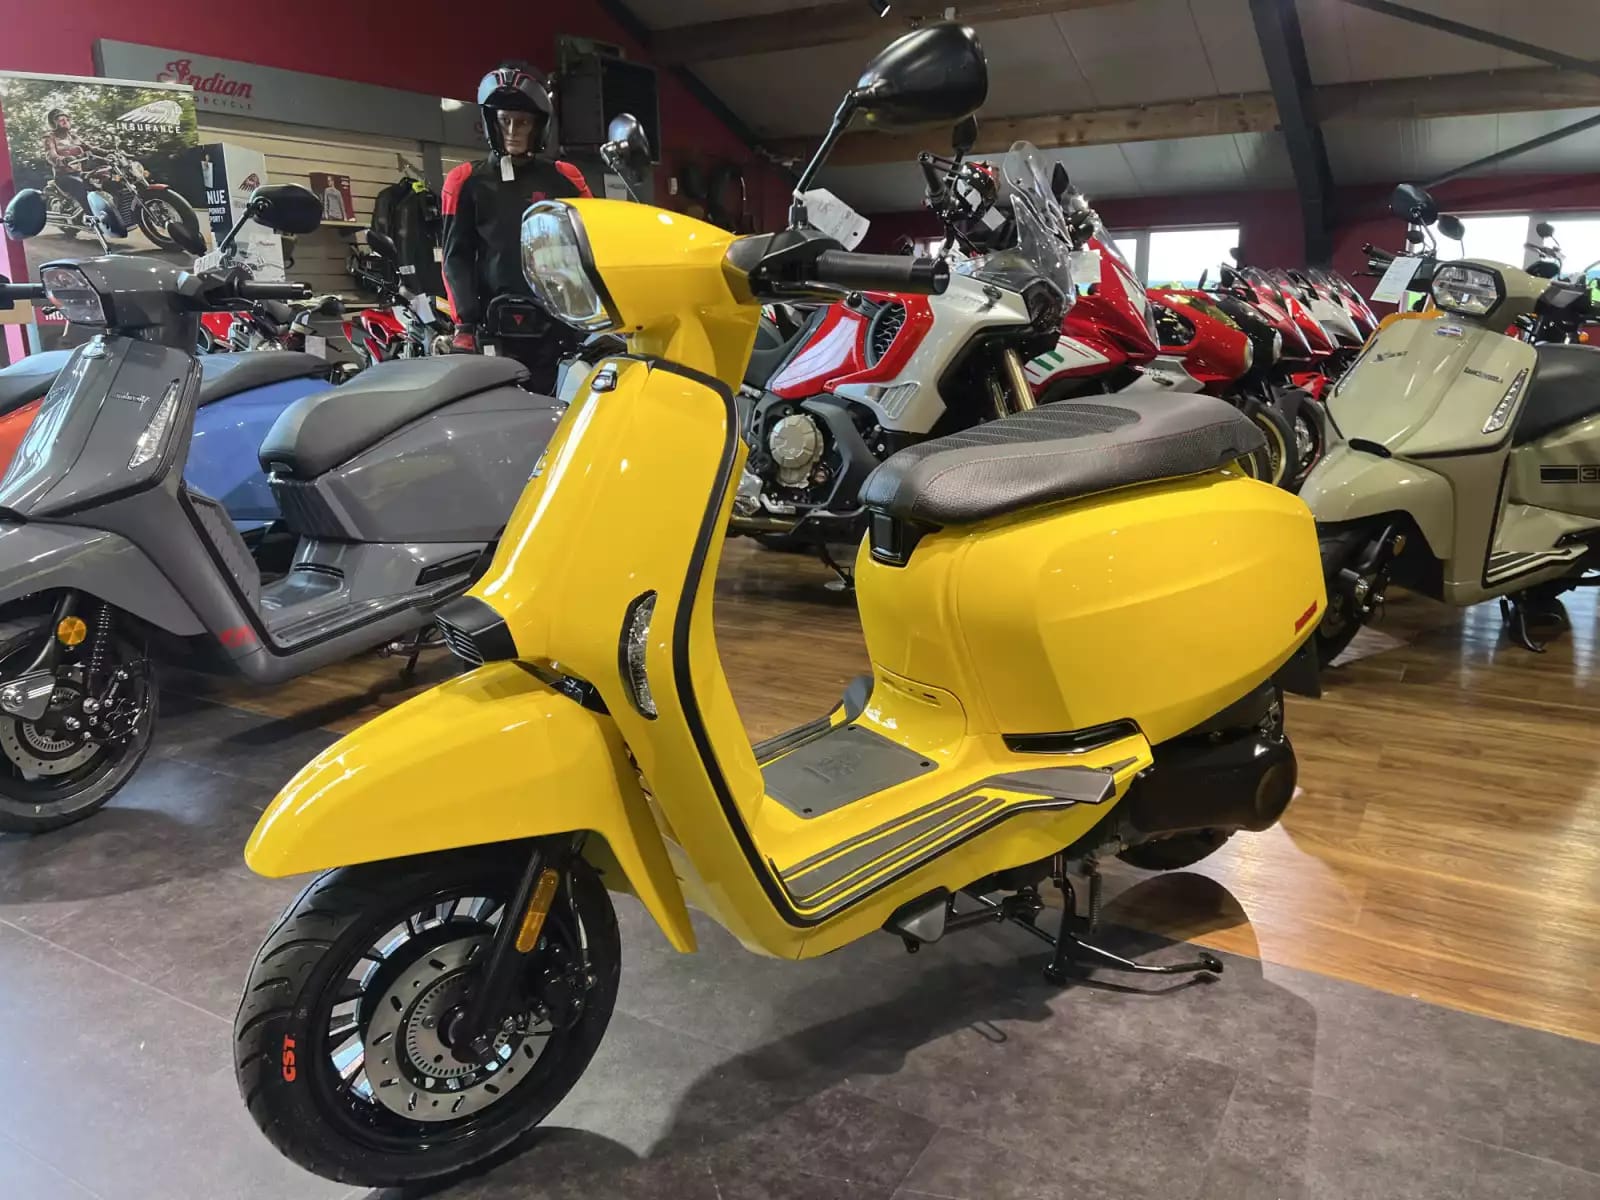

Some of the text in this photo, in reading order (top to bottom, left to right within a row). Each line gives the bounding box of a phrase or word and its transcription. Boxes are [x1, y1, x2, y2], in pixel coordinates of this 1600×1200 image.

[157, 60, 252, 98] Indian
[116, 122, 181, 133] INSURANCE
[206, 189, 228, 205] NUE
[283, 1034, 296, 1082] CST
